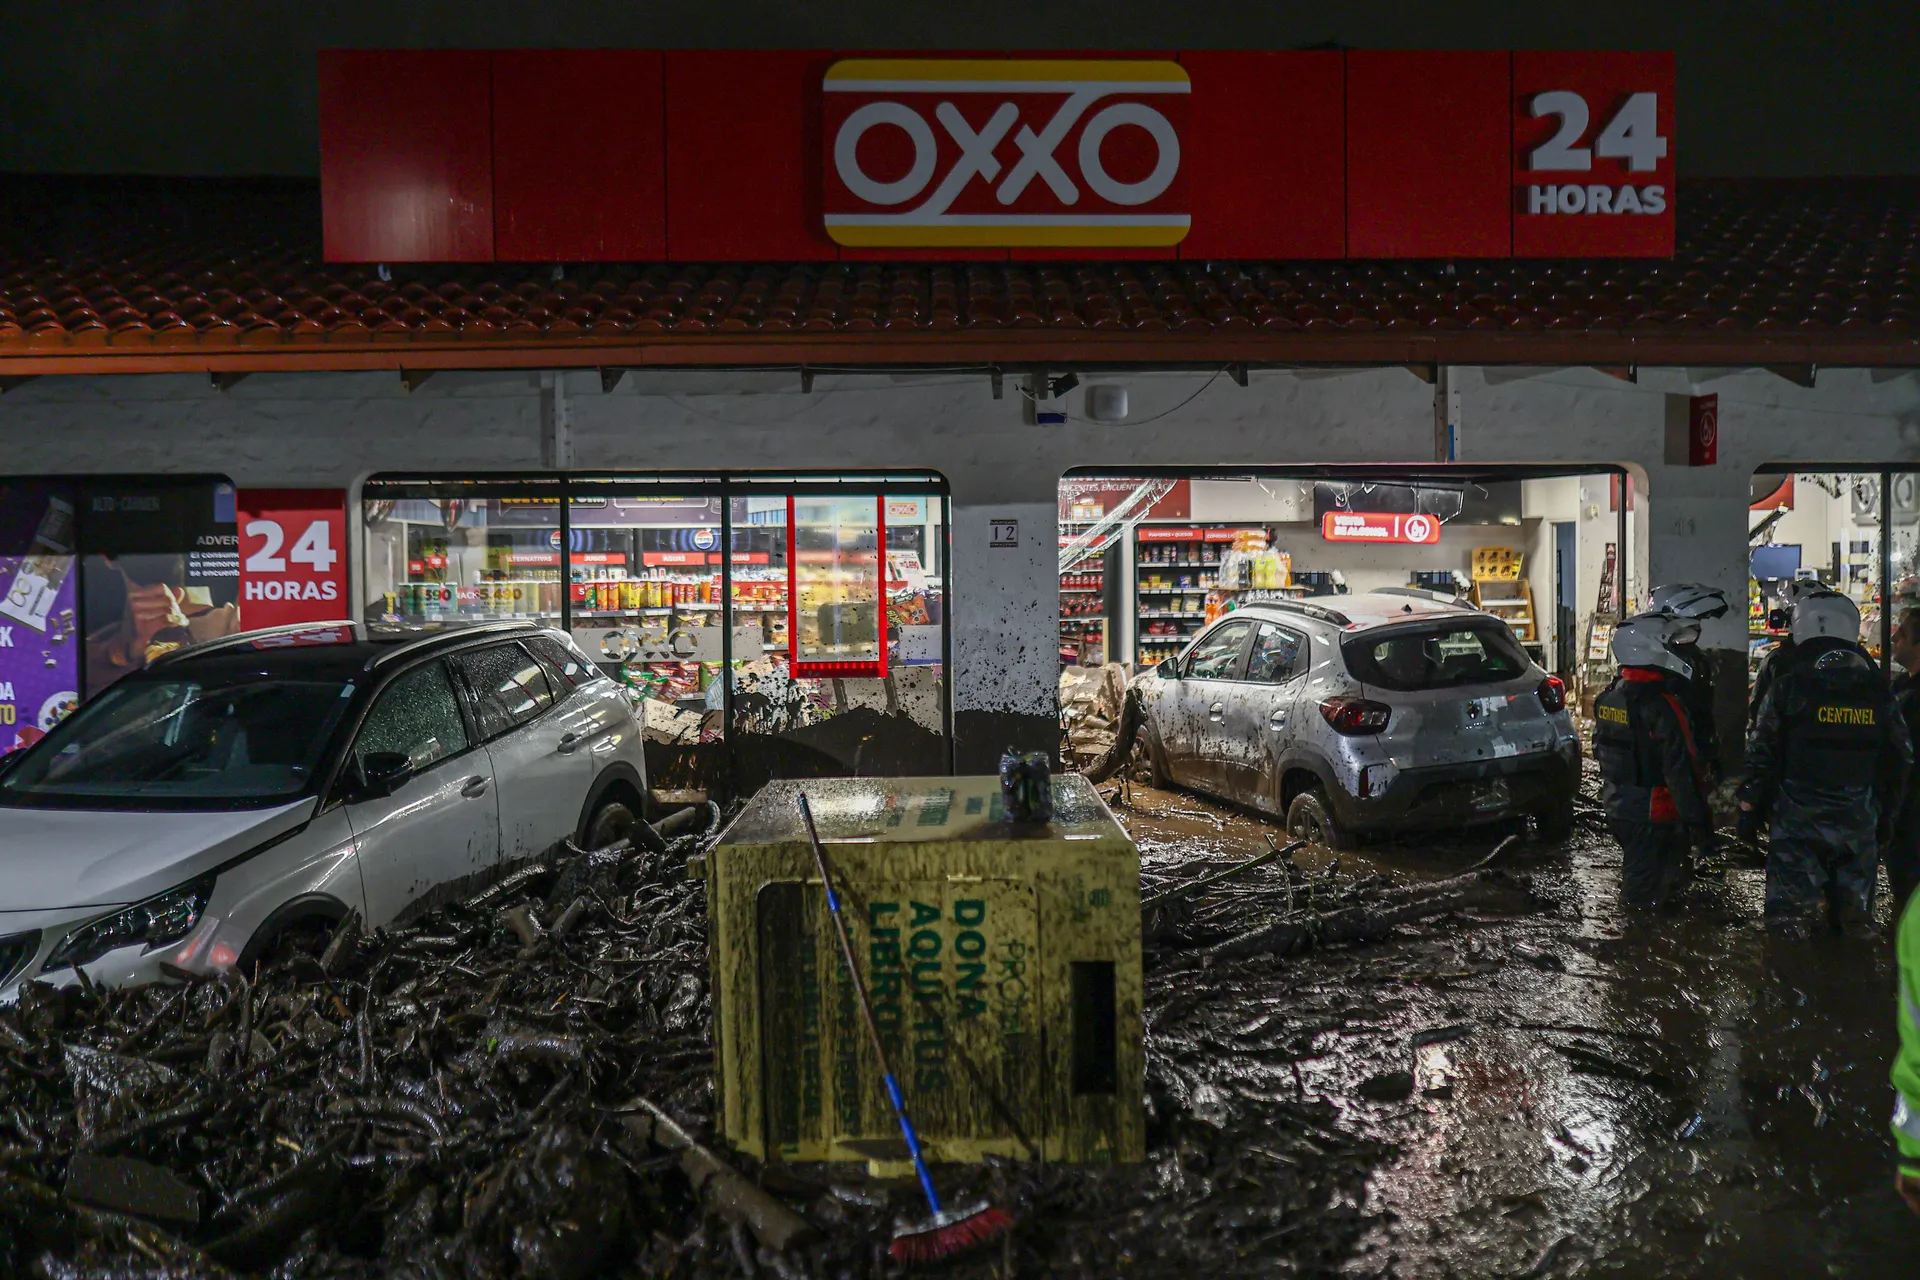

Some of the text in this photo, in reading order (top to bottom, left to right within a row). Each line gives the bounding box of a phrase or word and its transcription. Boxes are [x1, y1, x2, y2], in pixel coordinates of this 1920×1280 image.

[1530, 90, 1667, 171] 24
[833, 88, 1181, 216] OXXO
[1529, 184, 1667, 215] HORAS
[888, 504, 918, 515] OXXO
[245, 520, 337, 572] 24
[584, 554, 608, 562] JUGOS
[245, 580, 338, 601] HORAS
[1818, 706, 1877, 725] CENTINEL
[954, 898, 987, 1021] DONA
